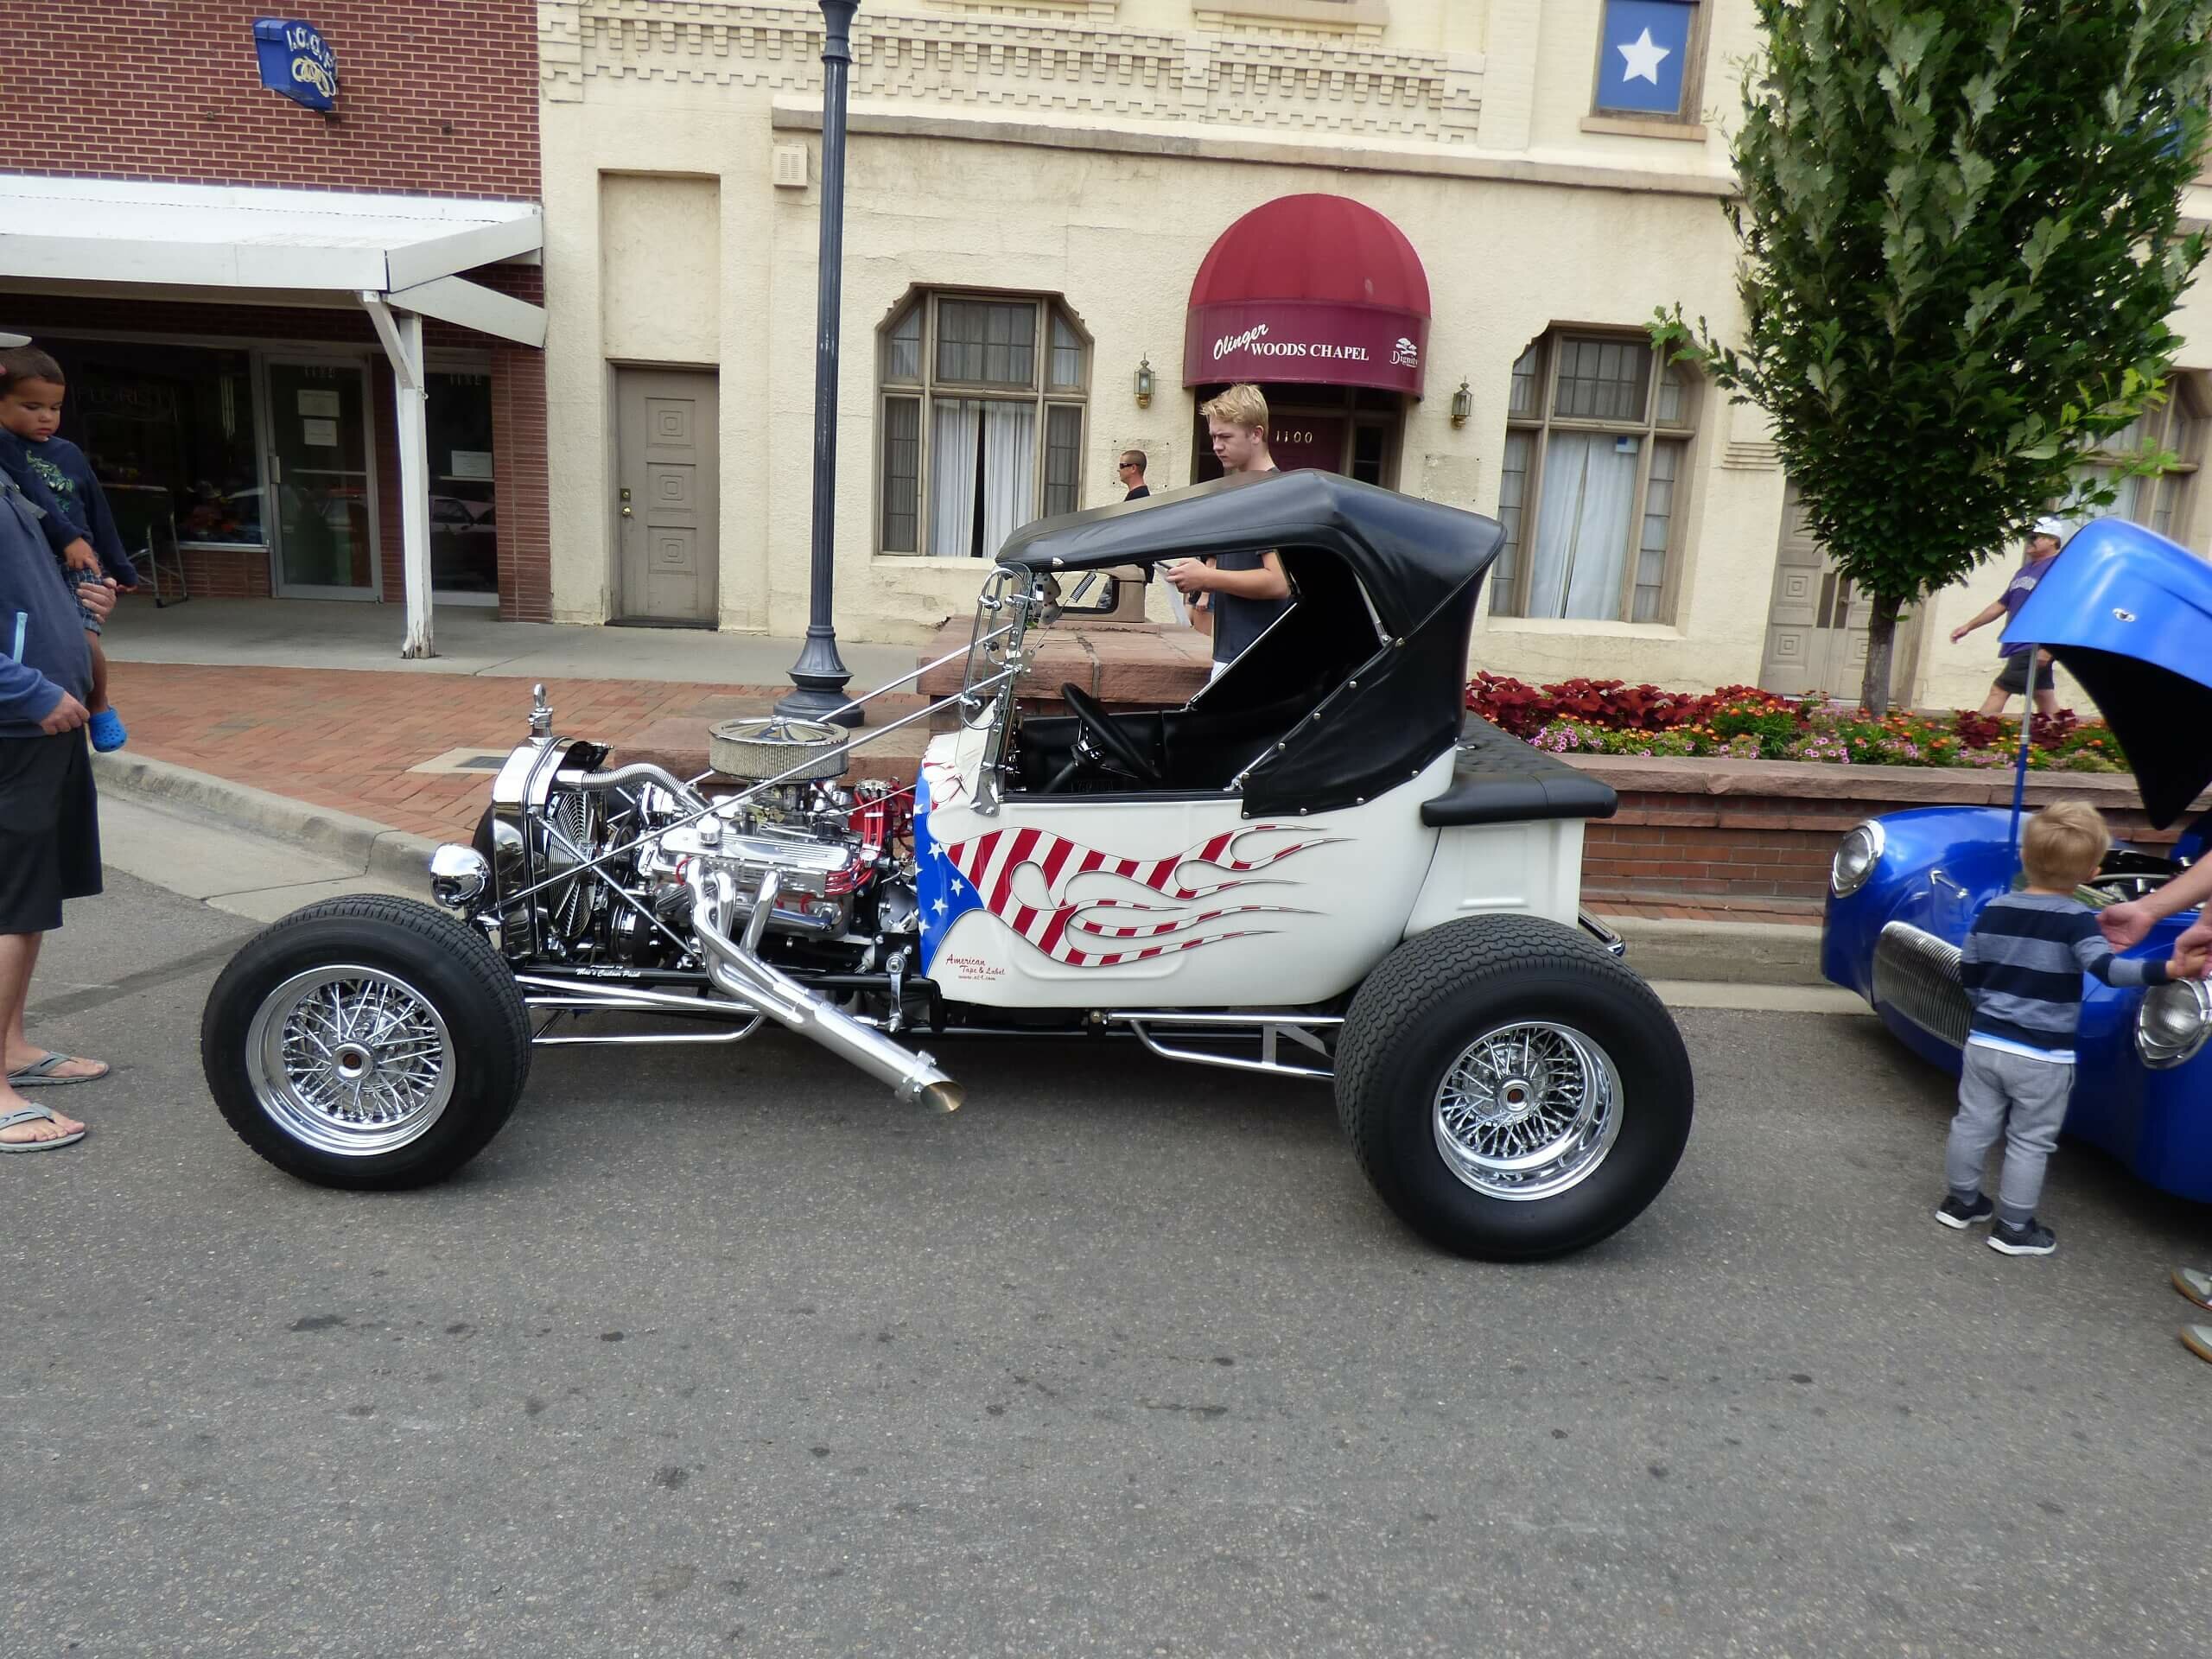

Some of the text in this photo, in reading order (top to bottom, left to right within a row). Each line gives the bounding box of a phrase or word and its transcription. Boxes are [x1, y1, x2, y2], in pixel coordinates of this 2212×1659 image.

[1213, 323, 1268, 360] Olinger
[1251, 342, 1370, 361] WOODS CHAPEL
[1275, 430, 1313, 443] 1100
[945, 953, 986, 966] American
[959, 965, 977, 975] Tape
[986, 967, 1006, 976] Label
